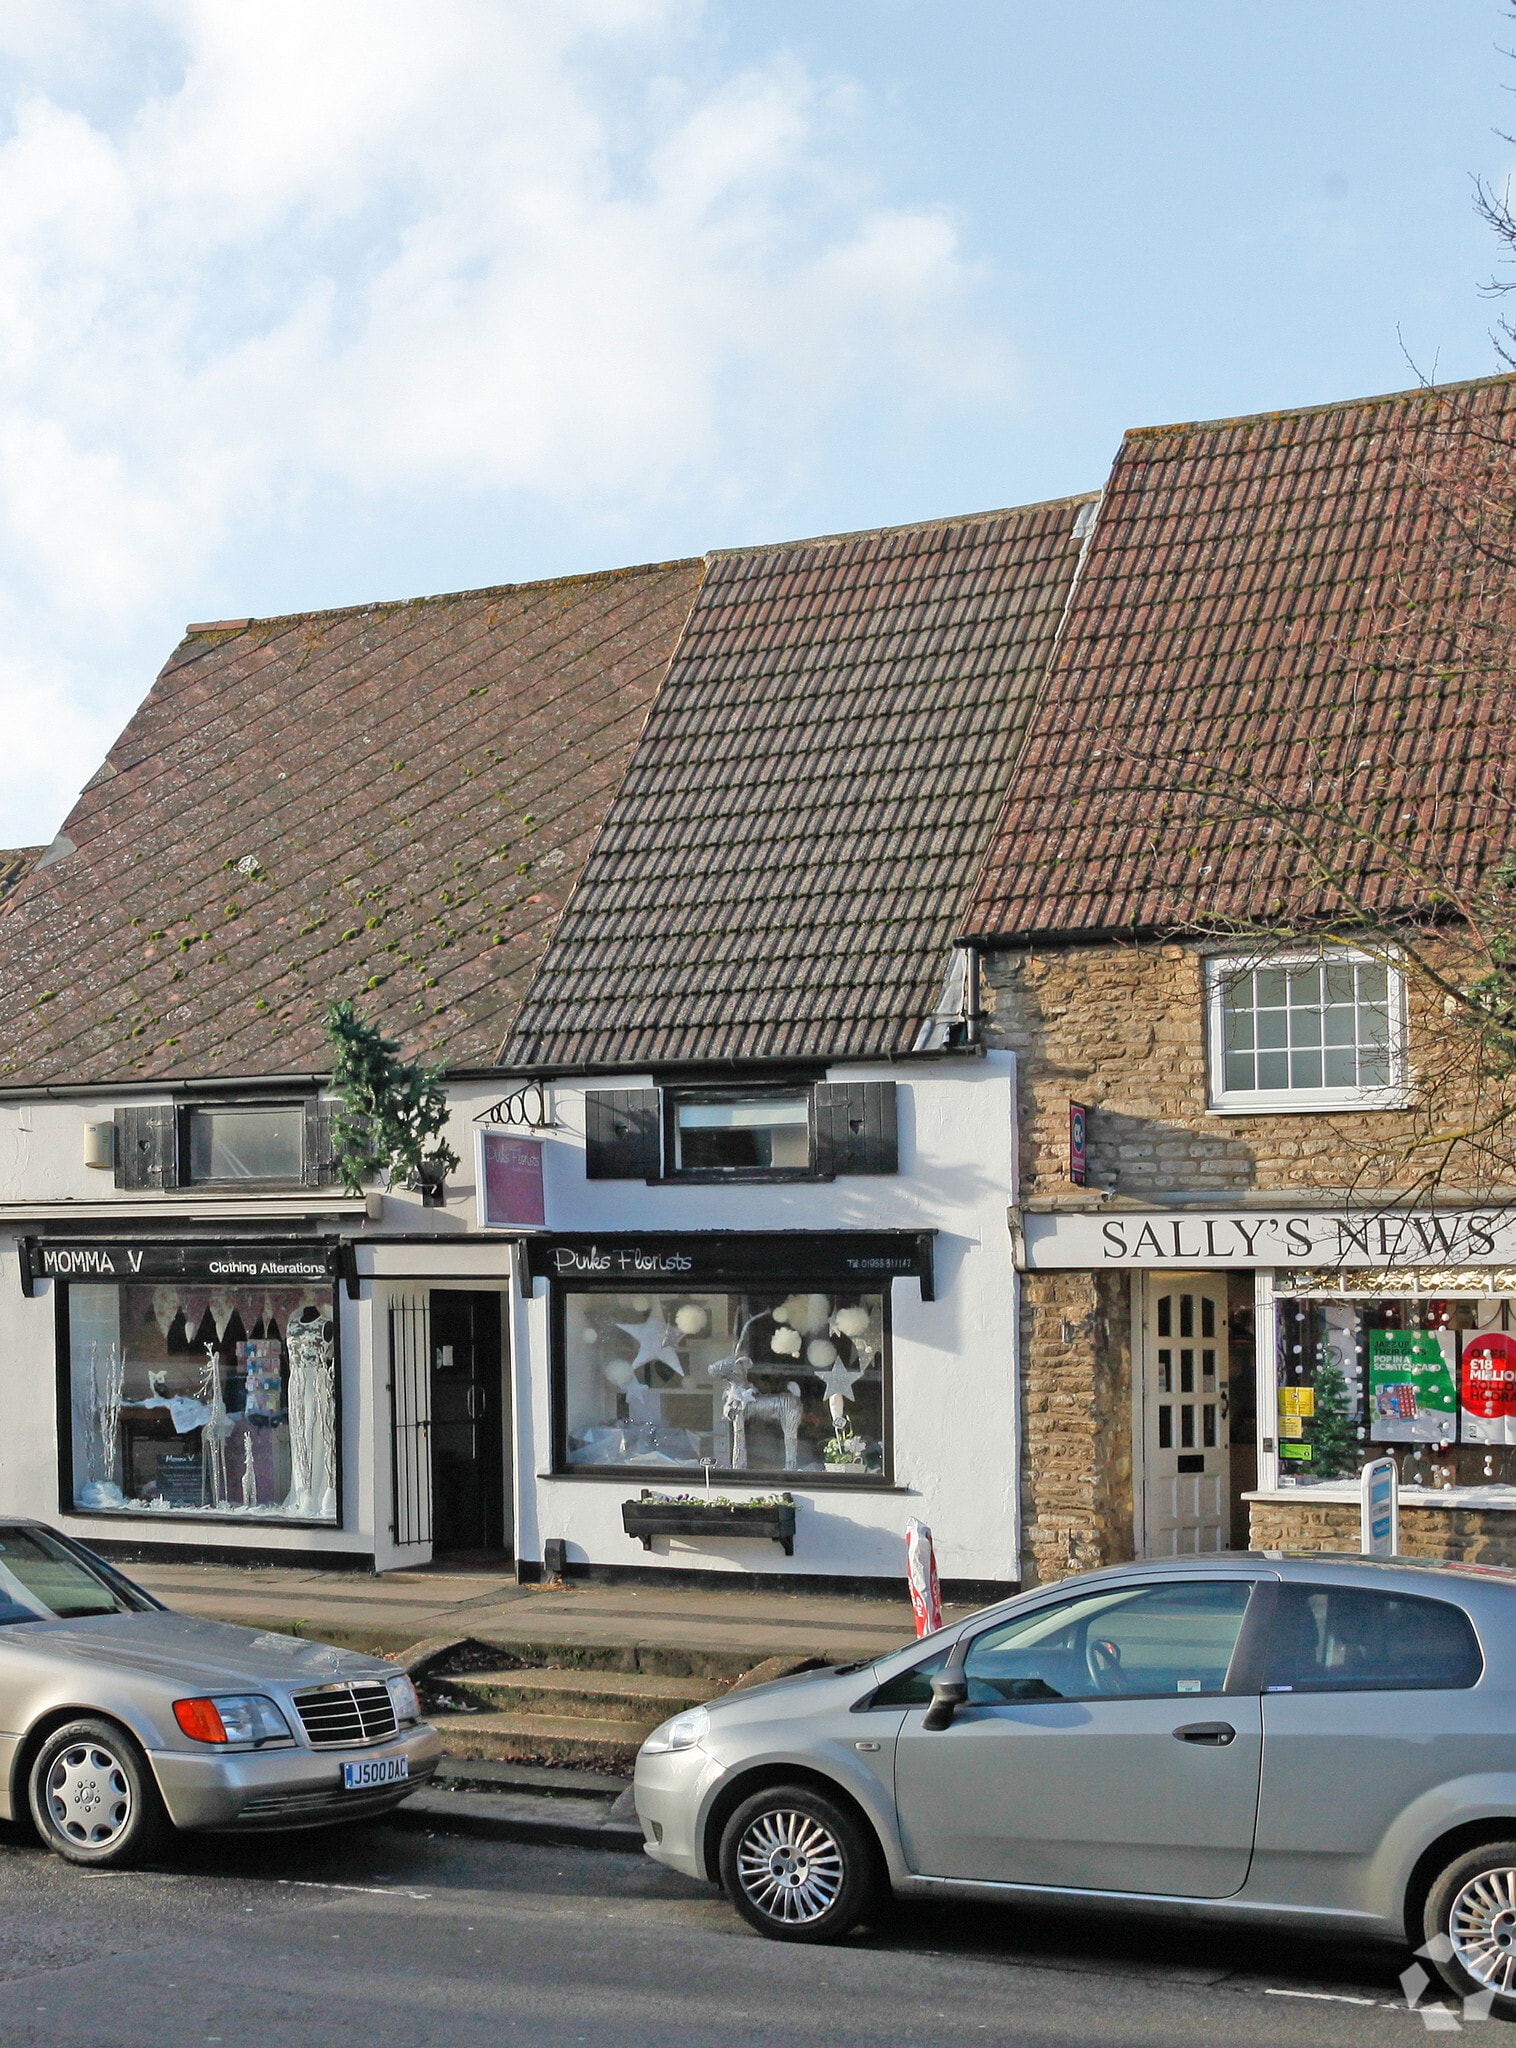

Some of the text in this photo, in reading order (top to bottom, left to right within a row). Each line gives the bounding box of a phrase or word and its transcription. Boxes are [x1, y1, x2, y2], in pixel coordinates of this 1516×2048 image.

[1101, 1215, 1496, 1259] SALLY'S NEWS
[44, 1250, 143, 1273] MOMMA V
[547, 1245, 692, 1272] Pinks Florists
[209, 1262, 326, 1275] Clothing Alterations
[1374, 1355, 1392, 1363] POP
[1393, 1355, 1402, 1363] IN
[1471, 1349, 1507, 1359] OER
[1470, 1359, 1493, 1370] £18
[1470, 1370, 1516, 1381] MILLIO
[1471, 1381, 1516, 1391] ROLLO
[354, 1758, 406, 1784] J500 DAC
